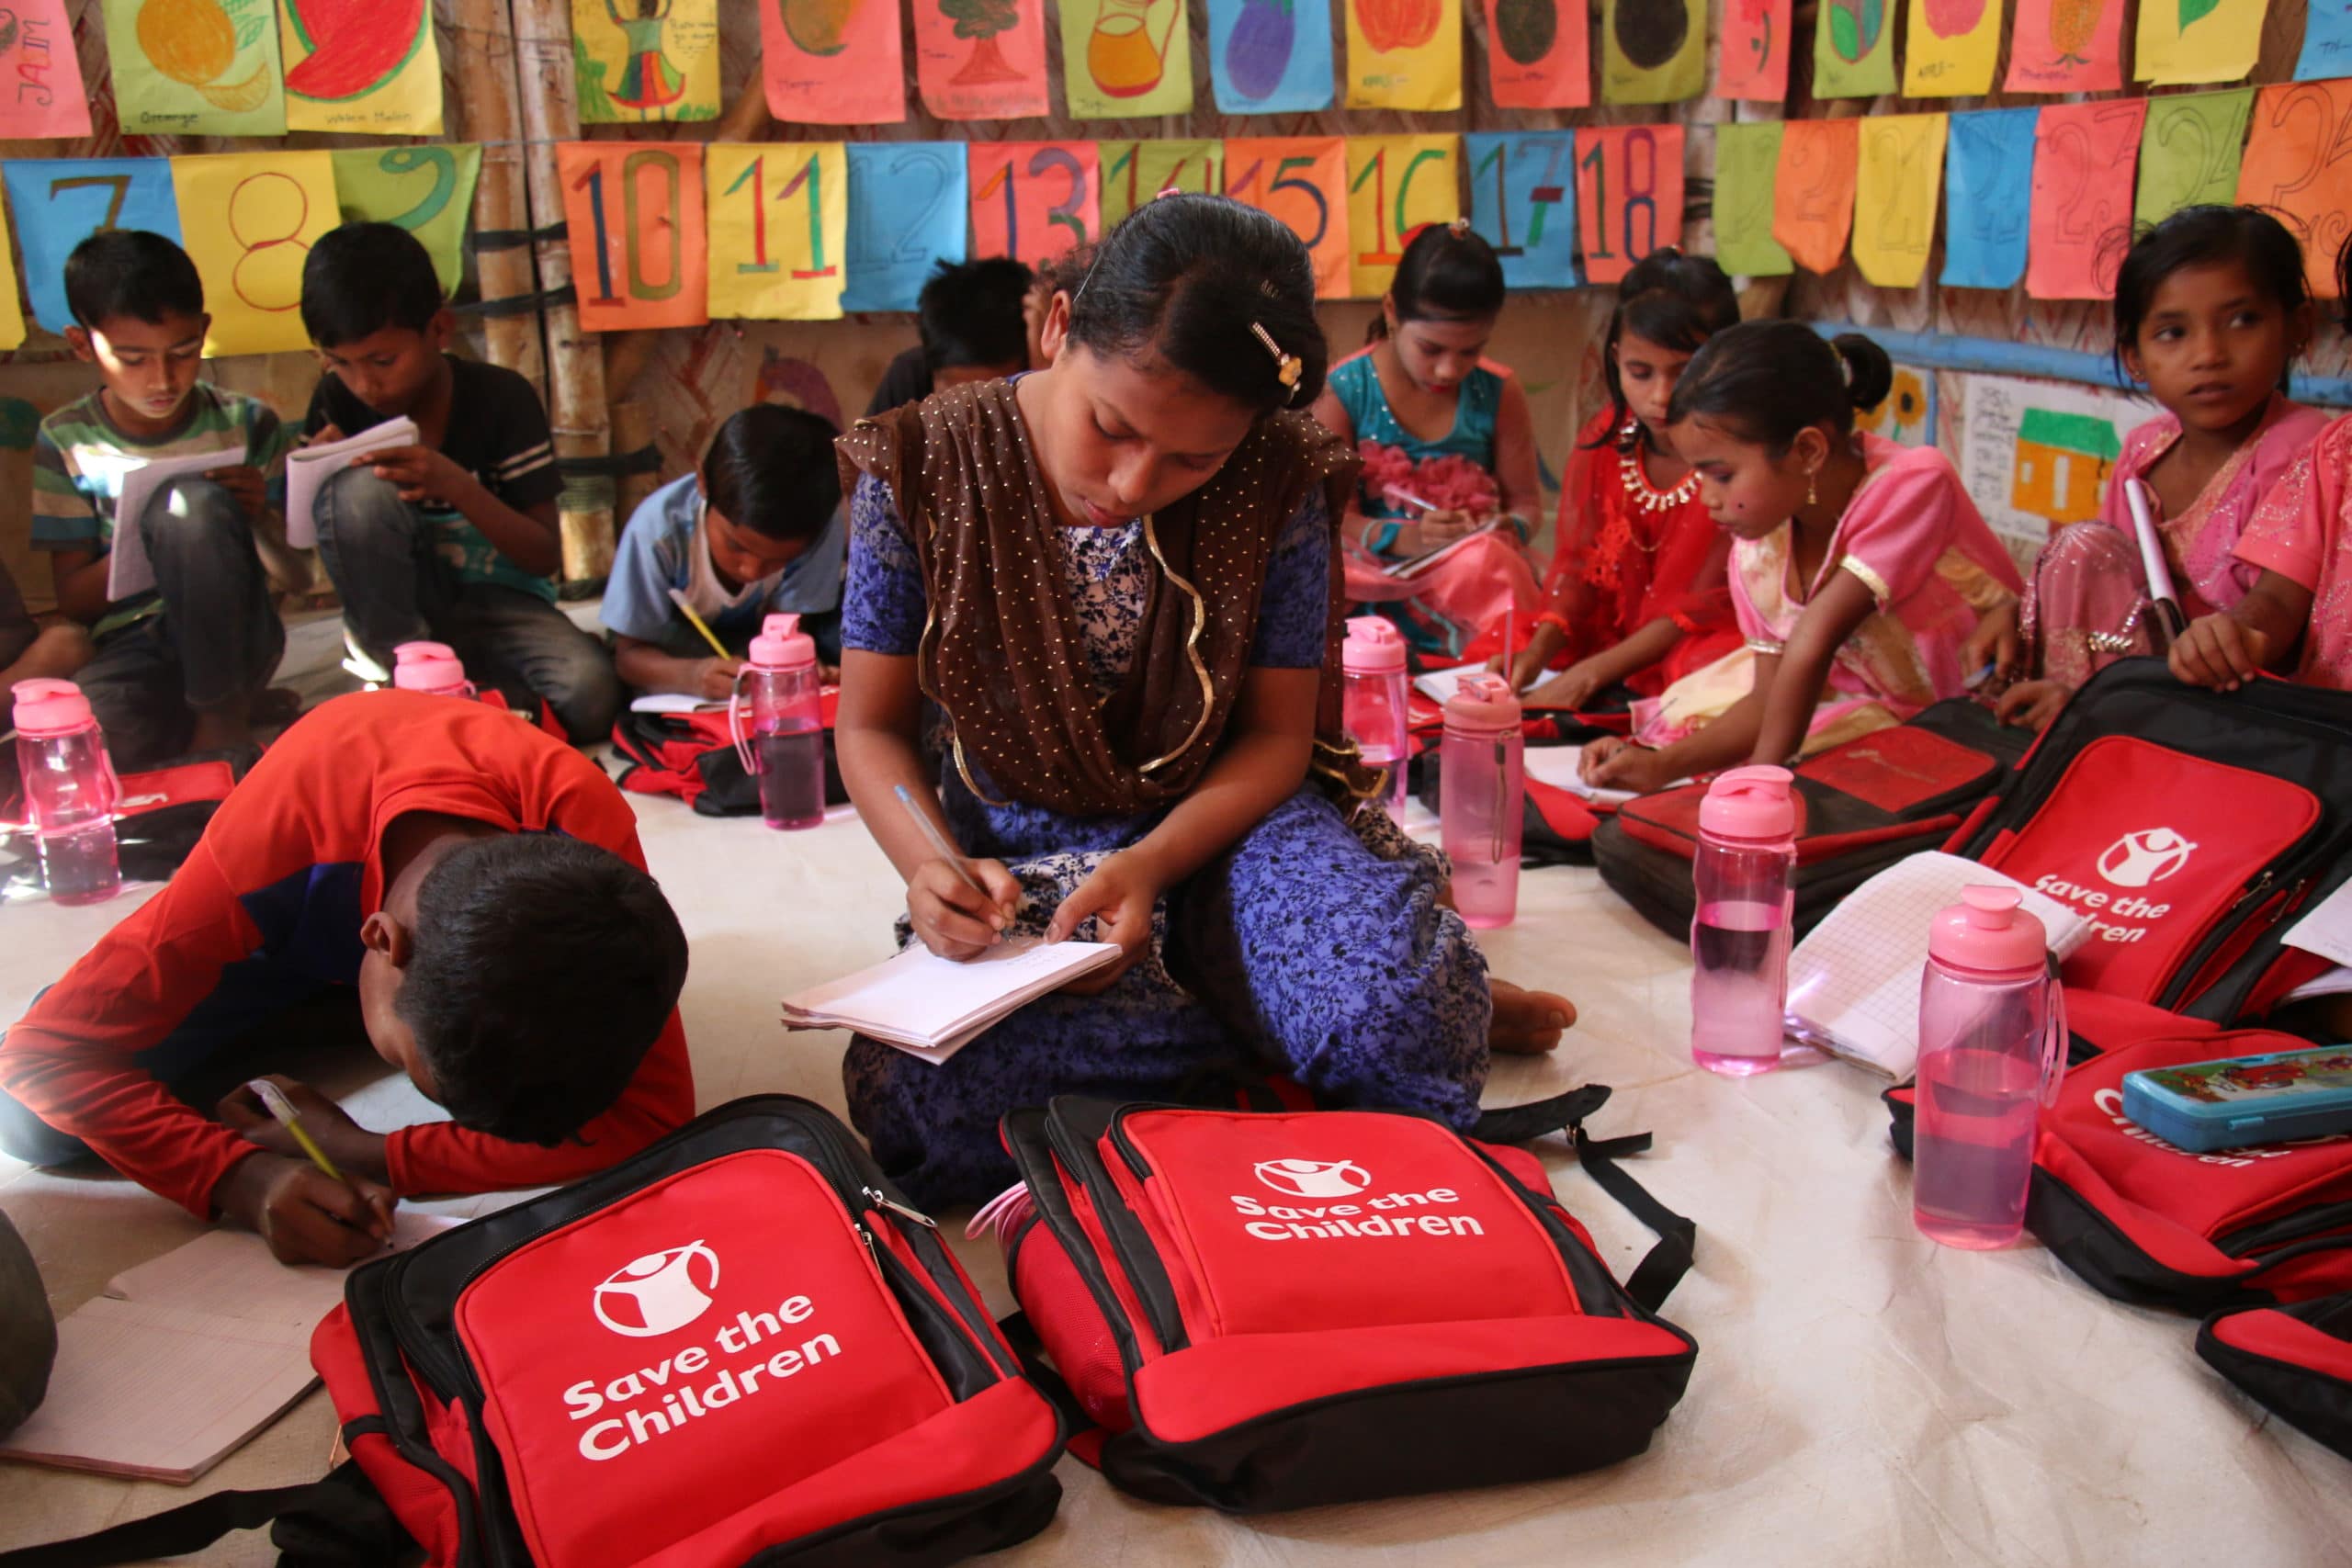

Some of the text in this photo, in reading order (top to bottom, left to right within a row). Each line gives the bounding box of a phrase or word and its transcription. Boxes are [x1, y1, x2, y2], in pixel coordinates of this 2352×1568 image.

[229, 172, 311, 311] 8
[571, 150, 681, 308] 10
[723, 151, 836, 278] 11
[849, 150, 948, 274] 12
[1474, 139, 1566, 256] 17
[1582, 128, 1657, 265] 18
[2109, 897, 2171, 919] the
[1230, 1188, 1461, 1221] Save the
[1244, 1214, 1485, 1241] Children
[562, 1294, 815, 1421] Save the
[578, 1333, 842, 1461] Children
